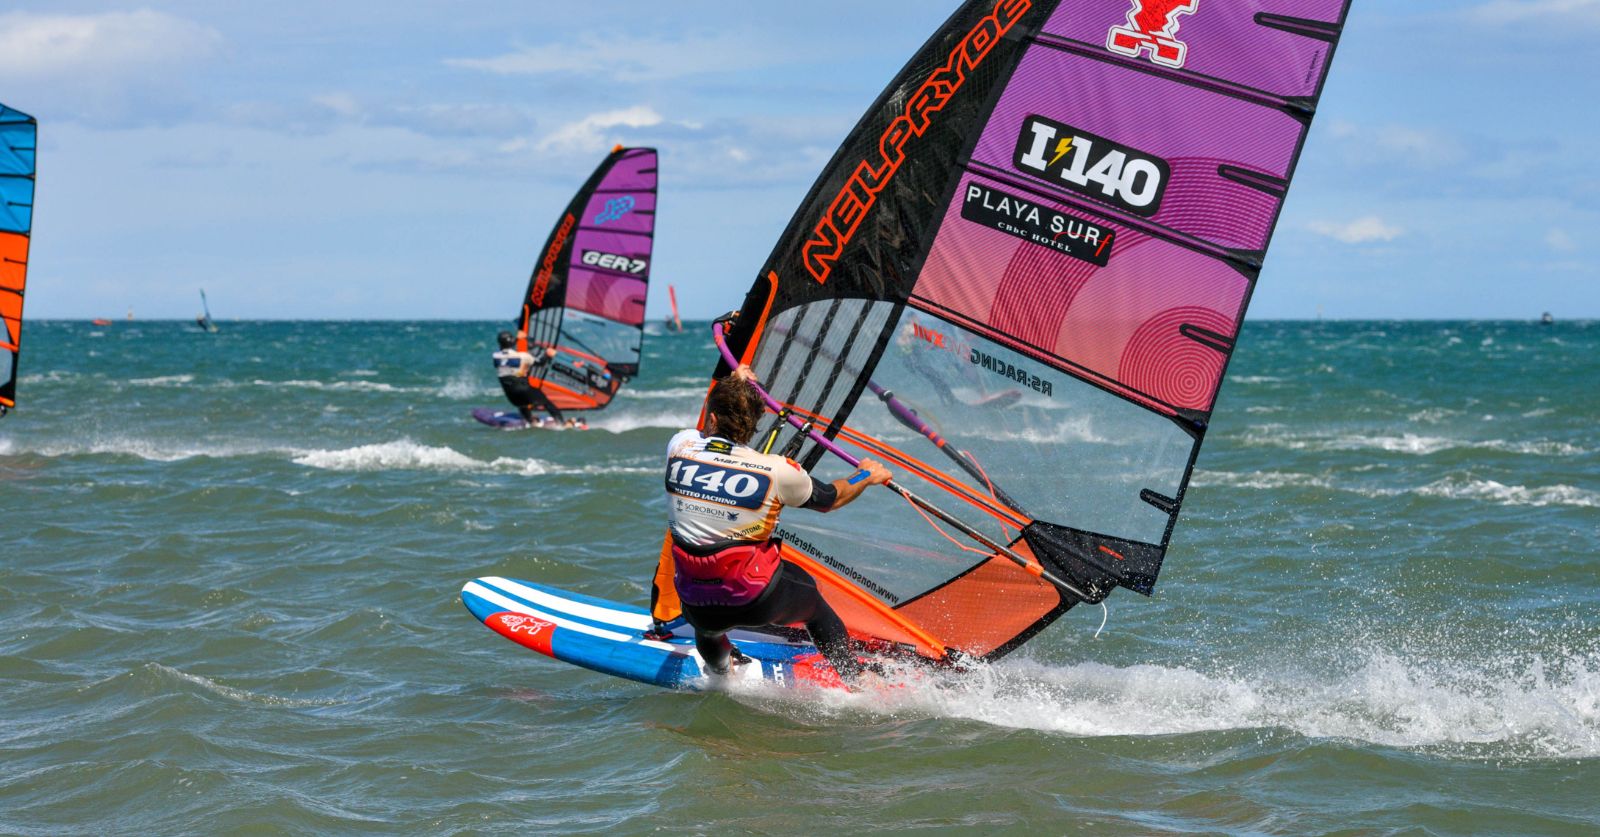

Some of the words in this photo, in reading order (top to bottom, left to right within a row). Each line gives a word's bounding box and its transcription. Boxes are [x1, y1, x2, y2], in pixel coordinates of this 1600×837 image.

[802, 0, 1032, 284] NEILPRYDE
[966, 185, 1040, 226] PLAYA
[1032, 233, 1072, 252] HOTEL
[669, 460, 759, 498] 1140
[674, 487, 700, 498] MATTEO
[701, 493, 737, 506] IACHINO
[684, 502, 725, 517] SOROBON
